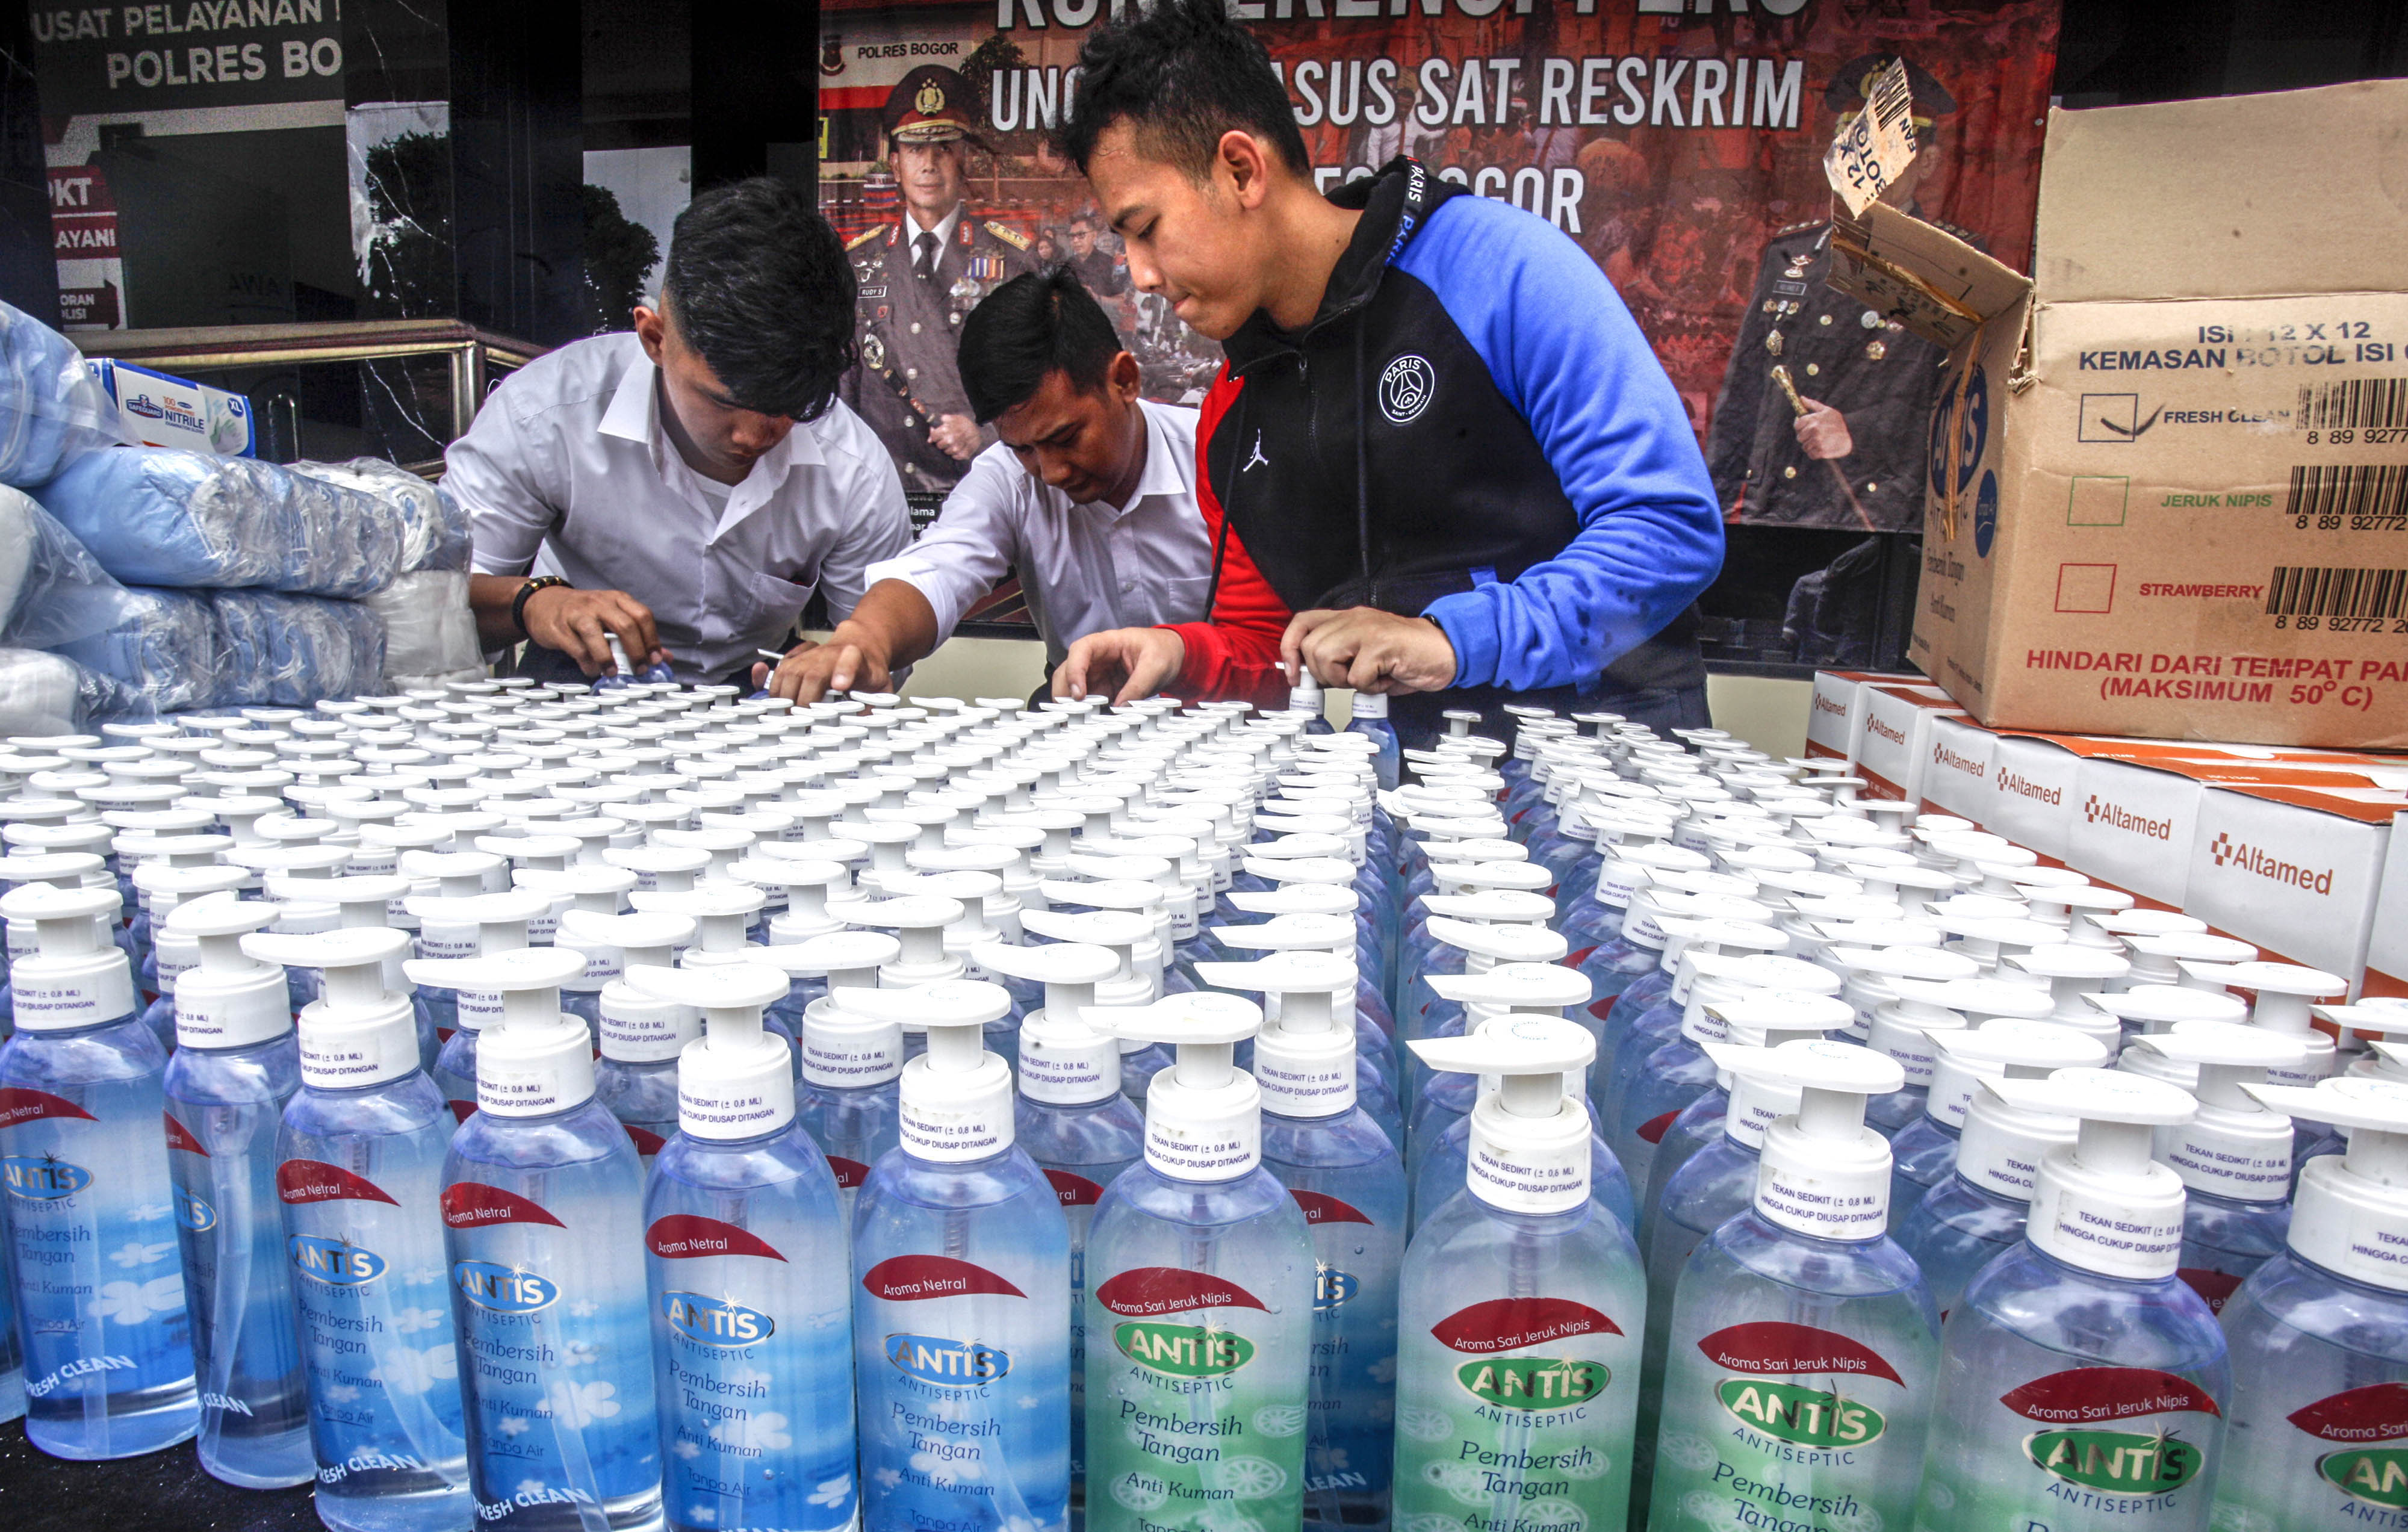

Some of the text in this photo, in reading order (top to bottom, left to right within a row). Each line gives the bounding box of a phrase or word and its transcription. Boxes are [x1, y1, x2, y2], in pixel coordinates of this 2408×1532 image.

[124, 0, 322, 36] PELAYANAN
[858, 42, 958, 58] POLRES BOGOR
[107, 38, 342, 89] POLRES BO
[1417, 57, 1803, 129] SAT RESKRIM
[1409, 164, 1425, 202] PARIS
[1848, 164, 1864, 189] 12
[55, 229, 116, 248] AYANI
[2306, 324, 2327, 340] X
[2336, 321, 2371, 340] 12
[2079, 349, 2226, 371] KEMASAN
[2237, 345, 2345, 369] BOTOL
[2356, 343, 2394, 362] ISI
[1385, 359, 1421, 382] PARIS
[128, 403, 163, 417] SAFEGUARD
[163, 395, 175, 406] 100
[229, 399, 242, 412] XL
[165, 410, 205, 429] NITRILE
[2165, 411, 2223, 424] FRESH
[2307, 430, 2320, 445] 8
[2330, 430, 2354, 445] 89
[2161, 494, 2273, 507] JERUK NIPIS
[2295, 515, 2407, 531] 8 89 92772
[2140, 583, 2264, 599] STRAWBERRY
[2276, 615, 2286, 629] 8
[2297, 616, 2319, 630] 89
[2329, 618, 2384, 633] 92772
[2026, 649, 2143, 673] HINDARI
[2150, 653, 2222, 676] DARI
[2230, 656, 2353, 680] TEMPAT
[2100, 677, 2273, 703] (MAKSIMUM
[1822, 697, 1846, 716] Altamed
[1874, 719, 1905, 746] Altamed
[1943, 749, 1985, 777] Altamed
[2009, 774, 2061, 806] Altamed
[2100, 802, 2171, 842] Altamed
[2233, 843, 2333, 896] Altamed
[1170, 1141, 1199, 1153] SEDIKIT
[2216, 1153, 2251, 1165] SEDIKIT
[1187, 1152, 1250, 1168] DIUSAP DITANGAN
[1500, 1162, 1532, 1176] SEDIKIT
[2202, 1164, 2233, 1177] CUKUP
[4, 1162, 78, 1189] ANTIS
[1490, 1175, 1583, 1193] CUKUP DIUSAP DITANGAN
[308, 1183, 340, 1196] Netral
[1772, 1183, 1831, 1205] TEKAN SEDIKIT
[448, 1206, 511, 1224] Aroma Netral
[1786, 1205, 1882, 1223] CUKUP DIUSAP DITANGAN
[2079, 1211, 2152, 1235] TEKAN SEDIKIT
[658, 1237, 728, 1254] Aroma Netral
[2059, 1221, 2133, 1250] HINGGA CUKUP
[2352, 1244, 2397, 1262] HINGGA
[43, 1281, 92, 1294] Kuman
[459, 1268, 544, 1304] ANTIS
[883, 1277, 966, 1297] Aroma Netral
[1111, 1291, 1232, 1314] Aroma Sari Jeruk Nipis
[299, 1298, 383, 1333] Pembersih
[668, 1297, 759, 1340] ANTIS
[311, 1326, 367, 1356] Tangan
[462, 1327, 554, 1363] Pembersih
[672, 1332, 754, 1361] ANTISEPTIC
[1454, 1320, 1591, 1350] Aroma Sari Jeruk Nipis
[894, 1339, 996, 1377] ANTIS
[1126, 1329, 1240, 1368] ANTIS
[60, 1355, 138, 1378] CLEAN
[476, 1356, 538, 1386] Tangan
[1718, 1352, 1867, 1371] Aroma Sari Jeruk Nipis
[333, 1369, 383, 1389] Kuman
[669, 1358, 766, 1399] Pembersih
[898, 1375, 990, 1402] ANTISEPTIC
[1129, 1366, 1233, 1394] ANTISEPTIC
[1471, 1366, 1594, 1398] ANTIS
[499, 1398, 553, 1421] Kuman
[682, 1388, 747, 1421] Tangan
[1474, 1405, 1588, 1429] ANTISEPTIC
[1731, 1386, 1867, 1441] ANTIS
[2027, 1394, 2189, 1419] Aroma Sari Jeruk Nipis
[892, 1401, 1001, 1437] Pembersih
[1120, 1400, 1243, 1437] Pembersih
[2320, 1423, 2376, 1439] Aroma
[707, 1435, 762, 1458] Kuman
[907, 1430, 981, 1463] Tangan
[1137, 1432, 1220, 1463] Tangan
[1458, 1439, 1593, 1470] Pembersih
[1733, 1427, 1855, 1467] ANTISEPTIC
[349, 1453, 421, 1473] CLEAN
[2046, 1438, 2188, 1482] ANTIS
[899, 1466, 995, 1496] Anti Kuman
[1126, 1472, 1234, 1501] Anti Kuman
[1481, 1471, 1569, 1501] Tangan
[1711, 1462, 1859, 1518] Pembersih
[515, 1485, 595, 1507] CLEAN
[2046, 1482, 2177, 1515] ANTISEPTIC
